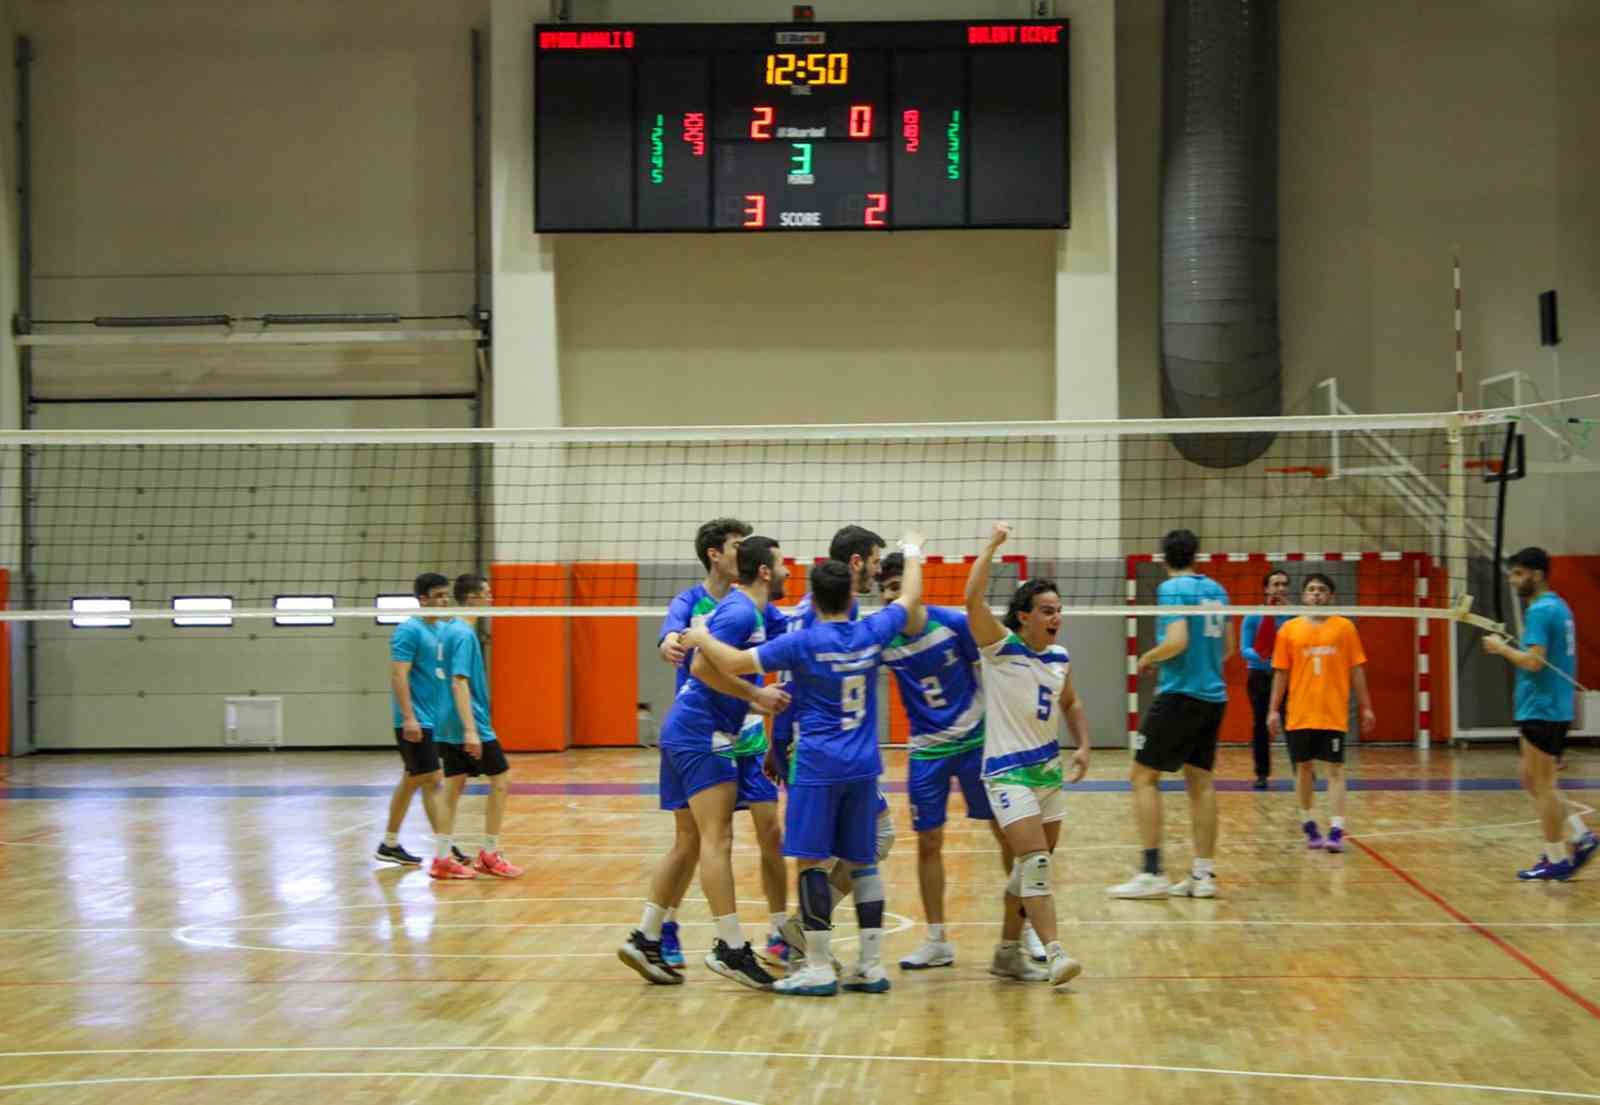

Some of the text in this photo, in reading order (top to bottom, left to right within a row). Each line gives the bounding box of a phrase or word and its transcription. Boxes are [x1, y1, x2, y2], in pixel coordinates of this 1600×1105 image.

[766, 53, 849, 85] 12:50
[750, 107, 773, 139] 2
[849, 106, 872, 137] 0
[790, 143, 812, 174] 3
[743, 194, 765, 227] 3
[779, 211, 822, 227] SCORE
[864, 192, 887, 226] 2
[841, 675, 867, 731] 9
[919, 676, 948, 709] 2
[1036, 684, 1054, 721] 5
[999, 792, 1012, 809] 5
